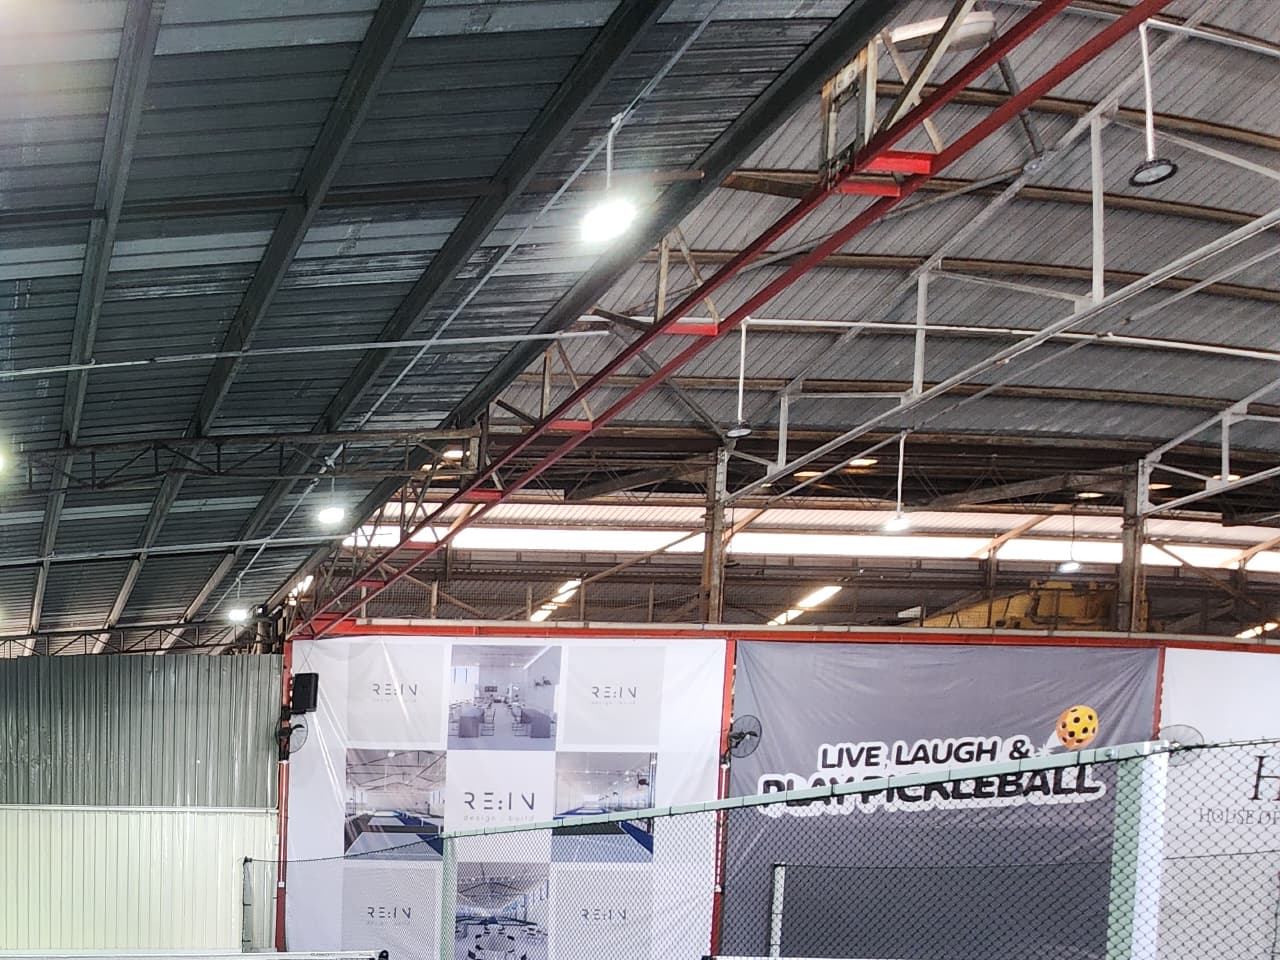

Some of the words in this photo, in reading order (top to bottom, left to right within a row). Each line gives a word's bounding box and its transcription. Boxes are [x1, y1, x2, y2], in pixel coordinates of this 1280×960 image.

[821, 745, 888, 769] LIVE,
[895, 740, 998, 766] LAUGH
[1008, 739, 1031, 761] &
[464, 792, 535, 810] RE:IN
